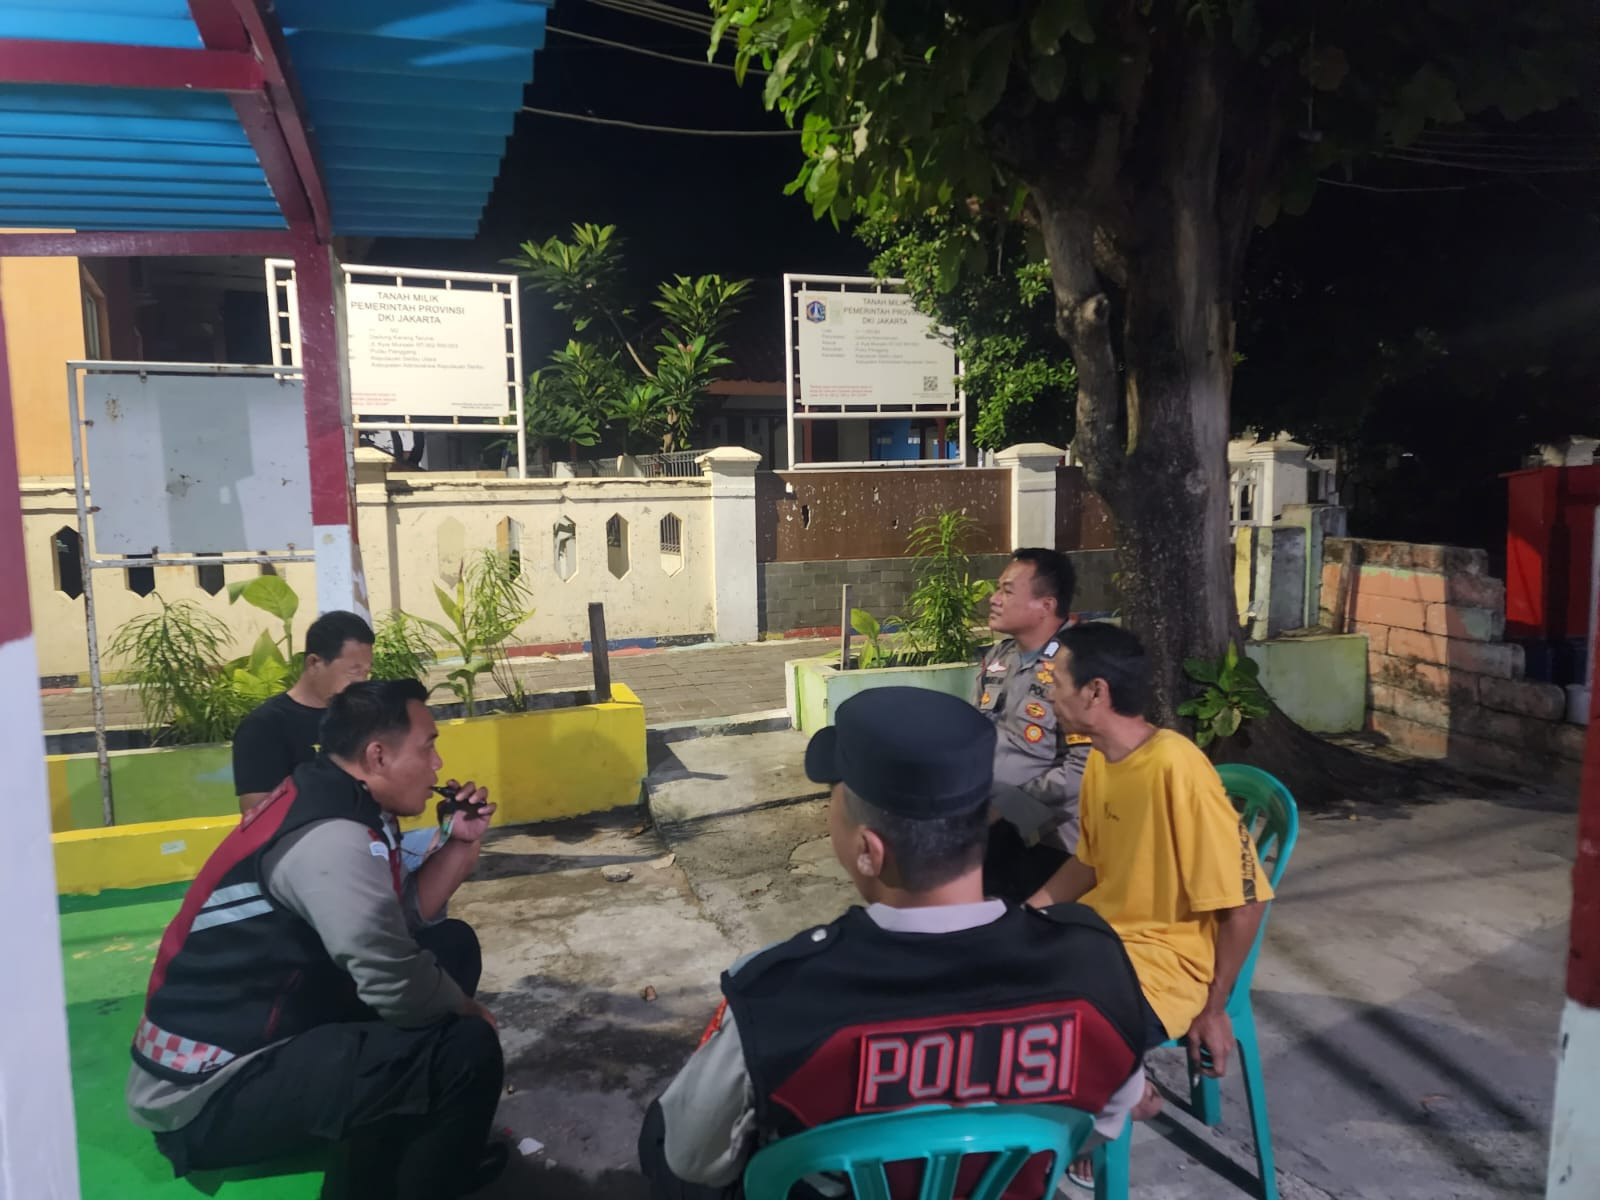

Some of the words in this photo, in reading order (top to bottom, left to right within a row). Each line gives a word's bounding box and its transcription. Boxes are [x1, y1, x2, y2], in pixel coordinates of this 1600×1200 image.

[377, 291, 410, 301] TANAH
[413, 294, 440, 303] MILIK
[350, 301, 416, 312] PEMERINTAH
[418, 304, 465, 315] PROVINSI
[377, 313, 395, 322] DKI
[398, 314, 442, 324] JAKARTA
[863, 1019, 1075, 1105] POLISI
